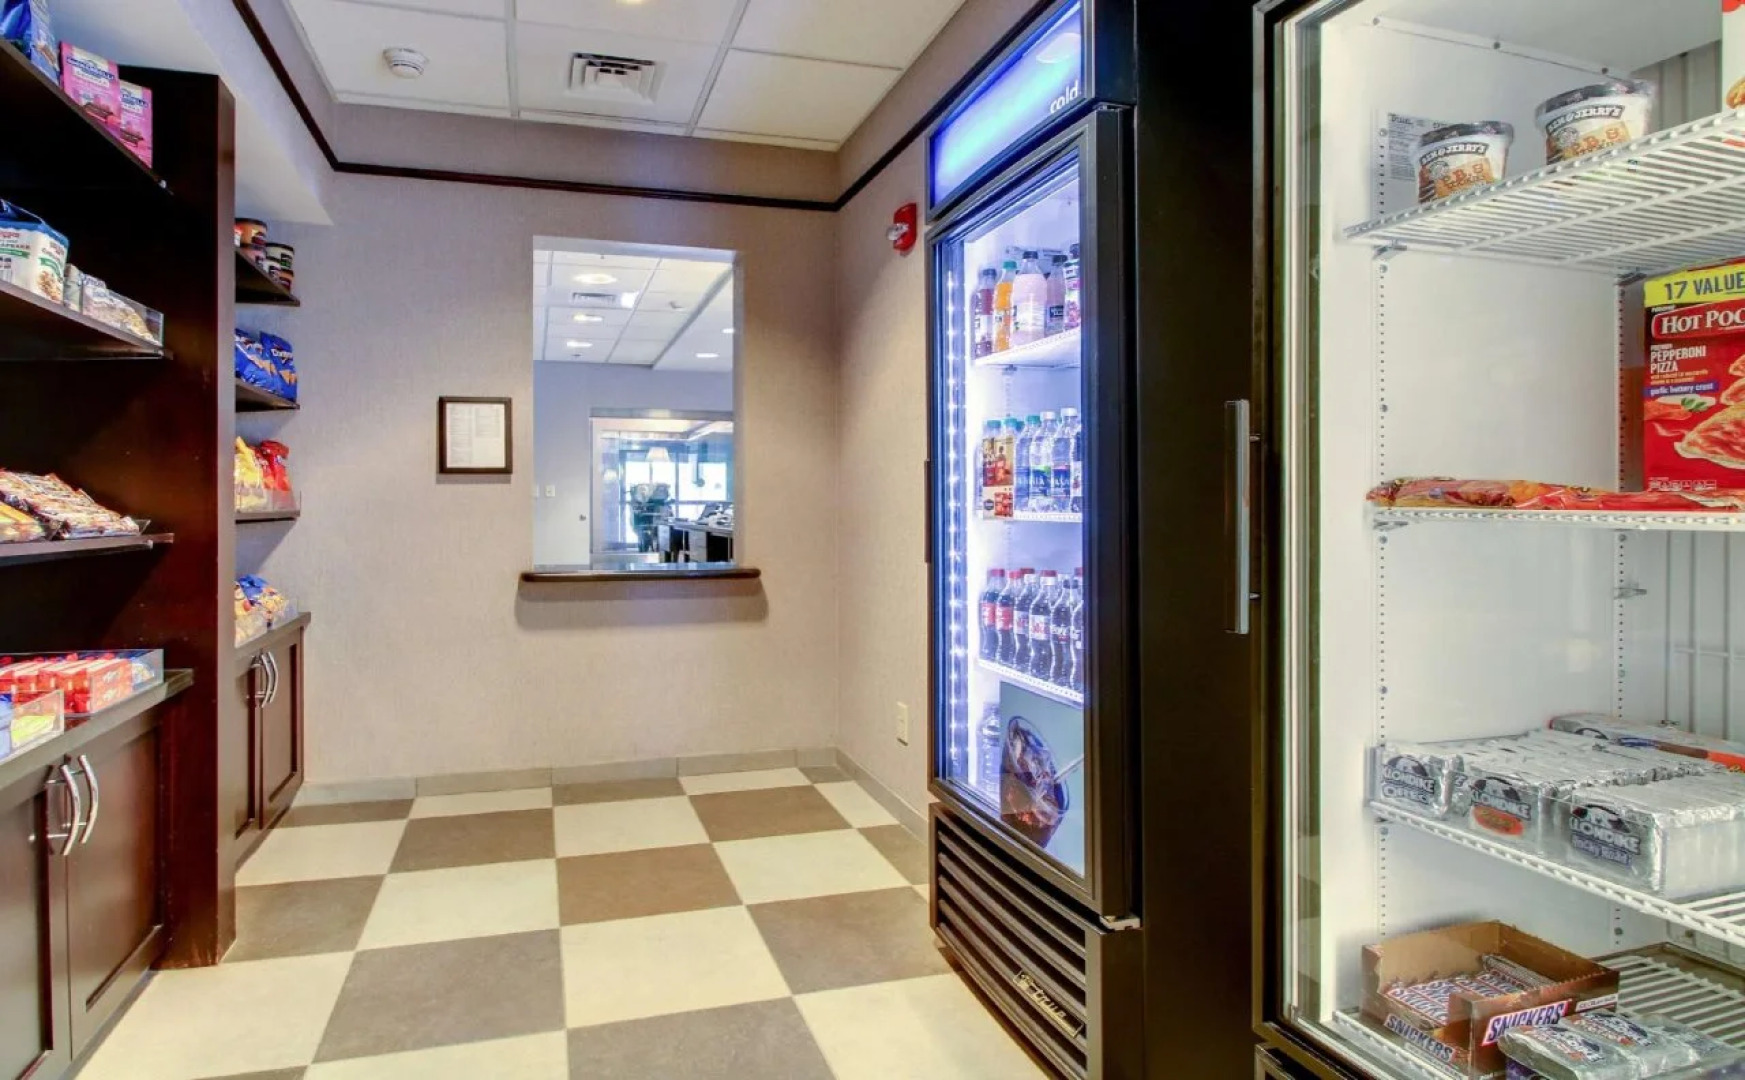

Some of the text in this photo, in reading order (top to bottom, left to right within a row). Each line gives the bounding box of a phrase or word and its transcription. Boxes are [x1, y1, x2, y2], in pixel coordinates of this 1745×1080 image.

[1050, 79, 1078, 114] cold
[1664, 271, 1745, 300] 17 VALUE
[1661, 314, 1704, 335] HOT
[1650, 345, 1707, 361] PEPPERONI
[1650, 360, 1679, 374] PIZZA
[1488, 1002, 1565, 1041] SNICKERS
[1386, 1014, 1453, 1061] SNICKERS
